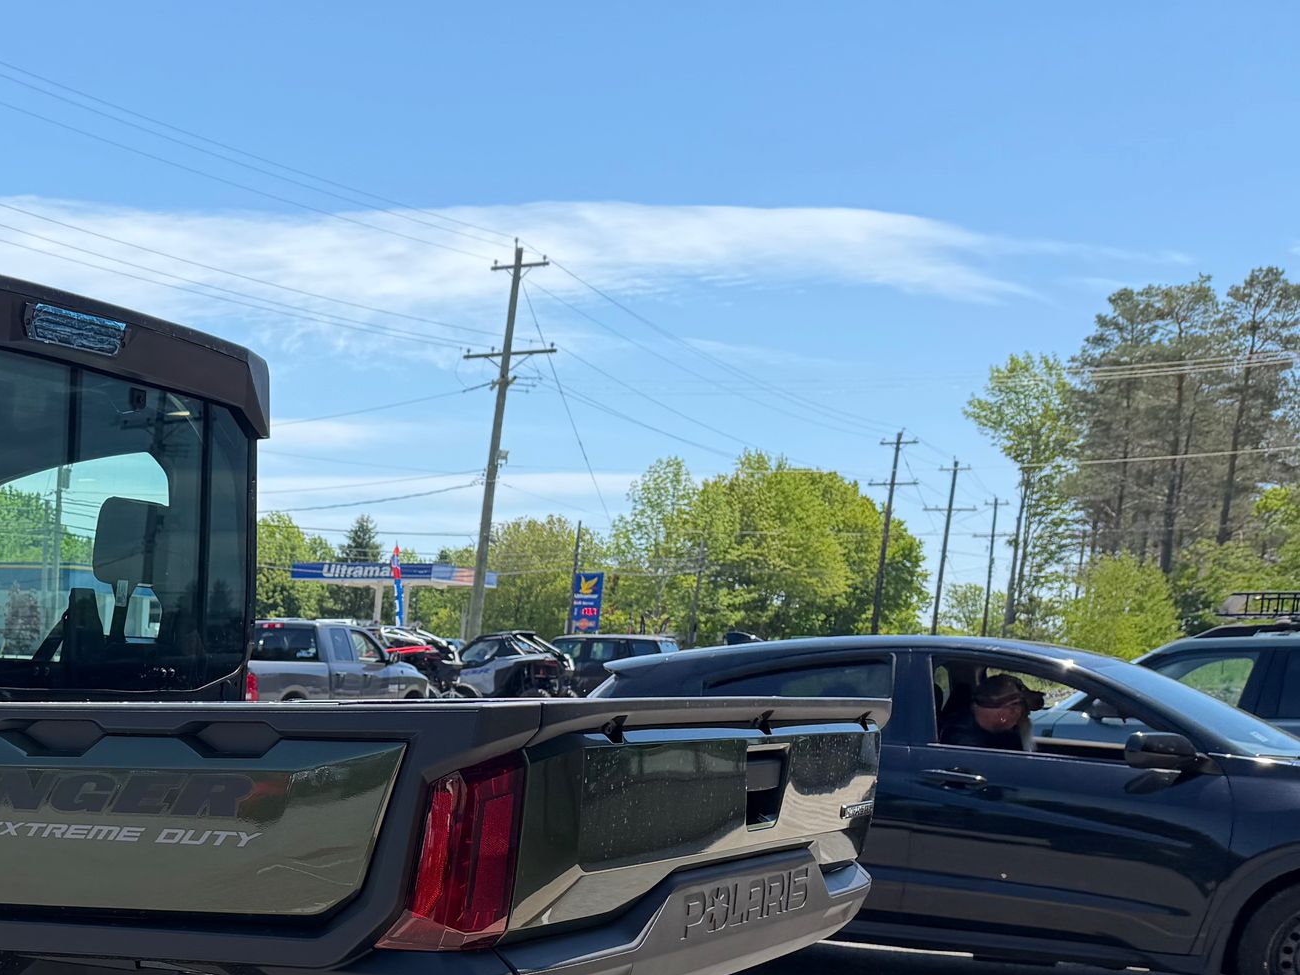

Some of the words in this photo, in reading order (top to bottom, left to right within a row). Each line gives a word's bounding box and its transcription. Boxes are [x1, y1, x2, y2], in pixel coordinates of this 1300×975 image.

[322, 563, 394, 578] Ultrama
[154, 828, 264, 849] DUTY
[680, 867, 809, 941] POLARIS
